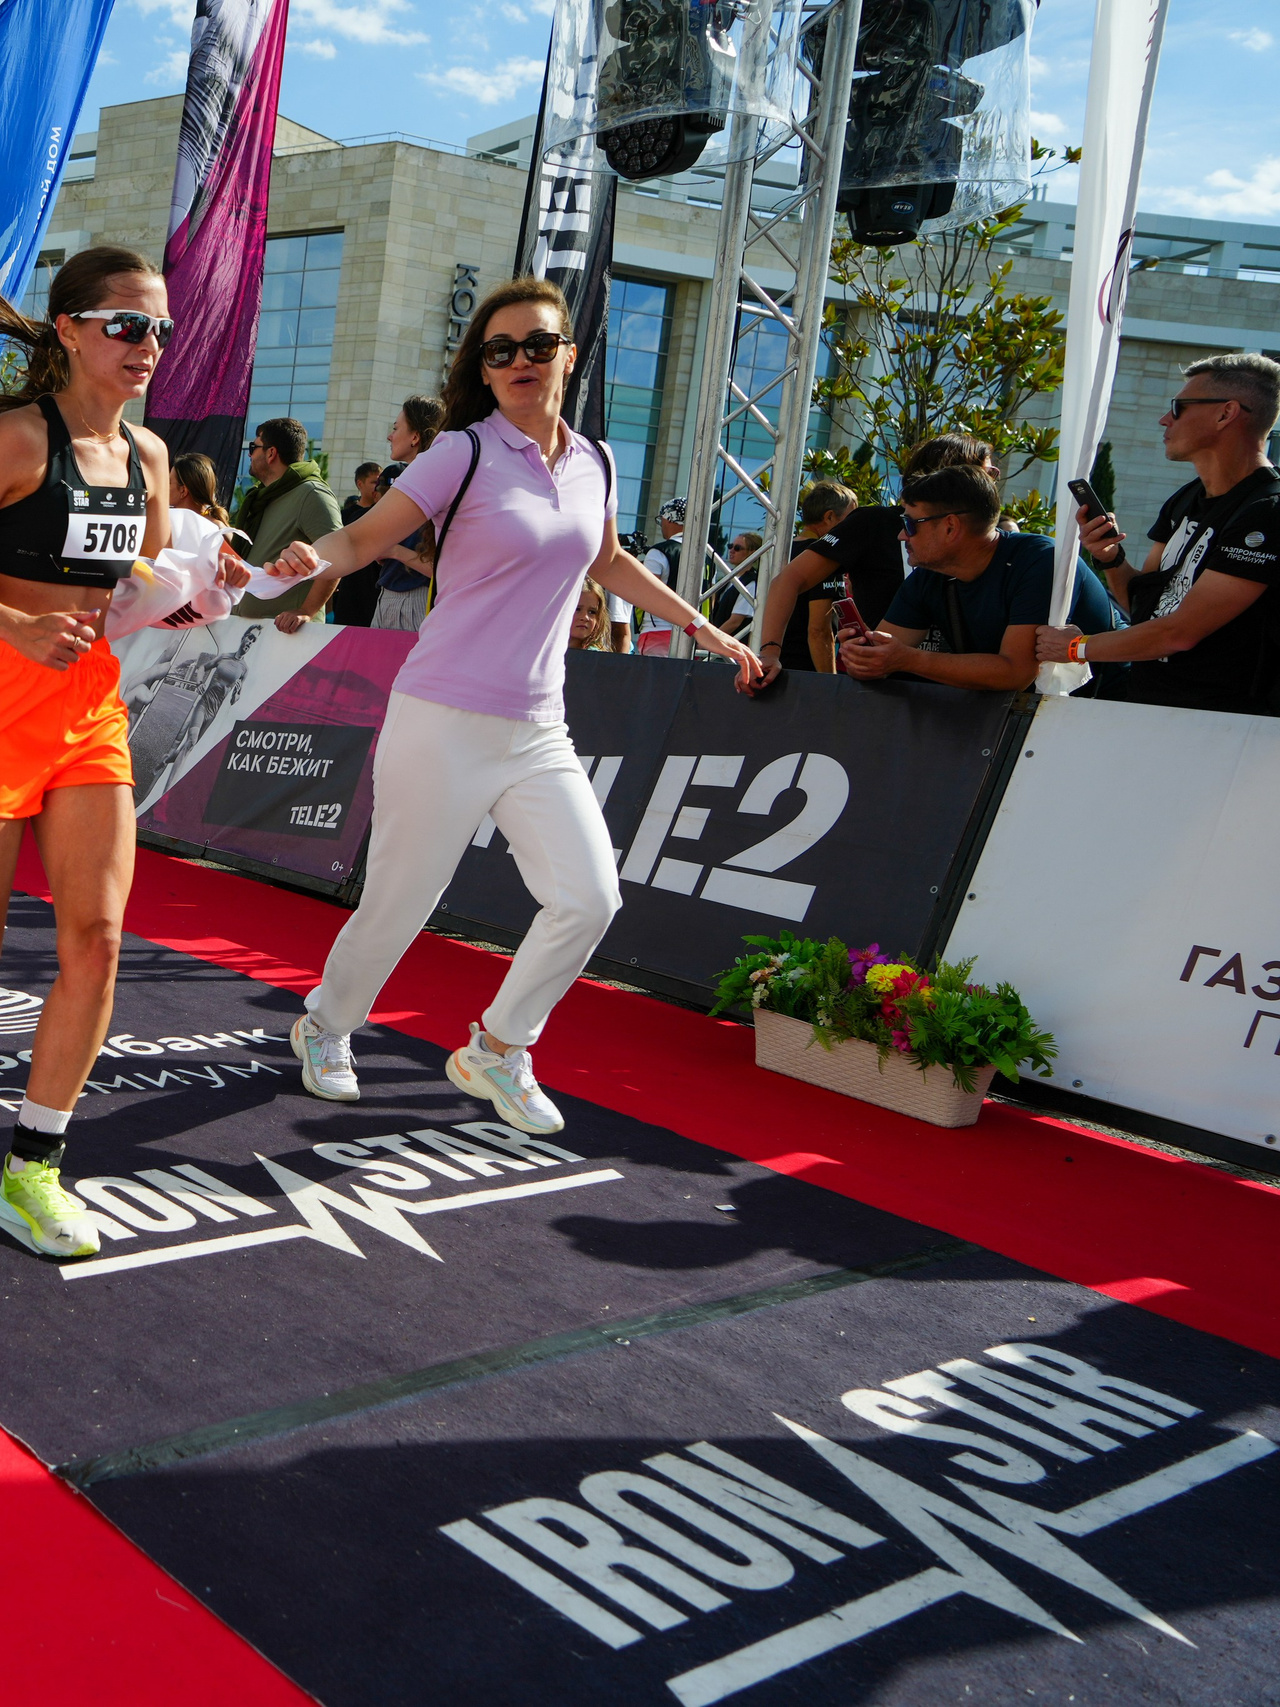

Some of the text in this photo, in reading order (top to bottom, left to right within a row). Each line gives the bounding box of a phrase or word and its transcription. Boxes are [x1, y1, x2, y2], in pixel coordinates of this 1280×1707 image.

[74, 498, 90, 507] STAR
[83, 522, 138, 554] 5708
[1191, 544, 1205, 564] 2023
[1220, 546, 1277, 562] ГАЗПРОМБАНК
[1227, 552, 1266, 565] ПРЕМИУМ
[235, 730, 313, 756] СМОТРИ,
[227, 752, 334, 778] КАК БЕЖИТ
[289, 803, 342, 829] TELE2
[331, 861, 344, 873] 0+
[312, 1121, 587, 1190] STAR
[438, 1342, 1204, 1650] IRON STAR
